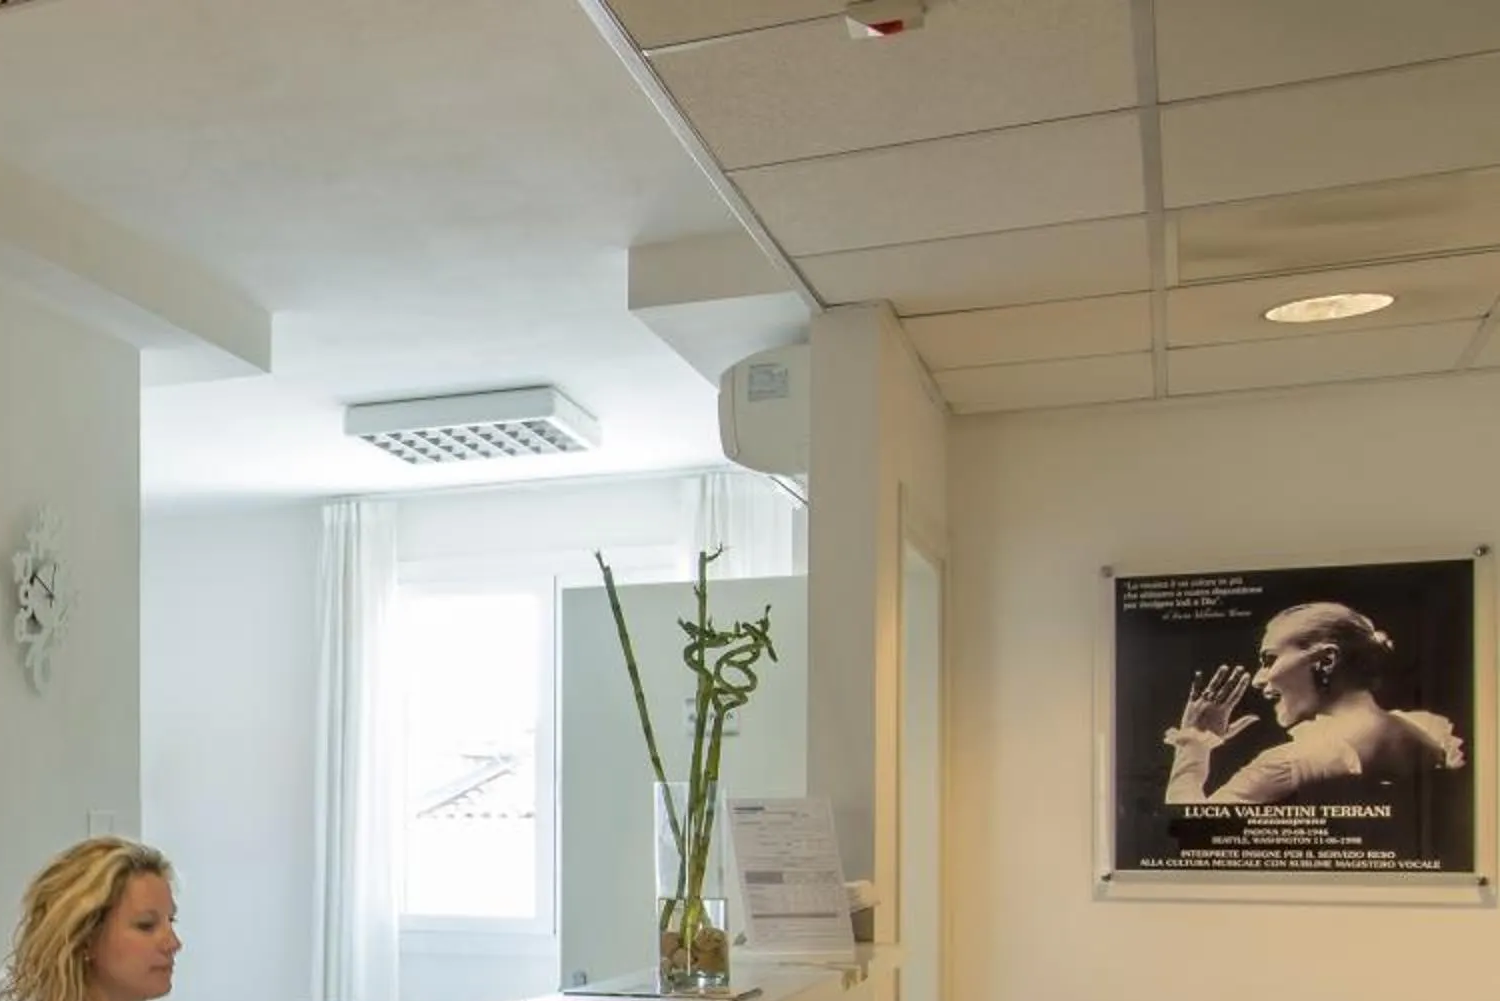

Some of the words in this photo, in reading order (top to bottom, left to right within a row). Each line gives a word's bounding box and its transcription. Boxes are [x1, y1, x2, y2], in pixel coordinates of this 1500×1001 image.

[1184, 805, 1231, 818] LUCIA
[1235, 804, 1316, 818] VALENTINI
[1320, 804, 1393, 818] TERRANI
[1139, 858, 1164, 868] ALLA
[1165, 859, 1210, 868] CULTURA
